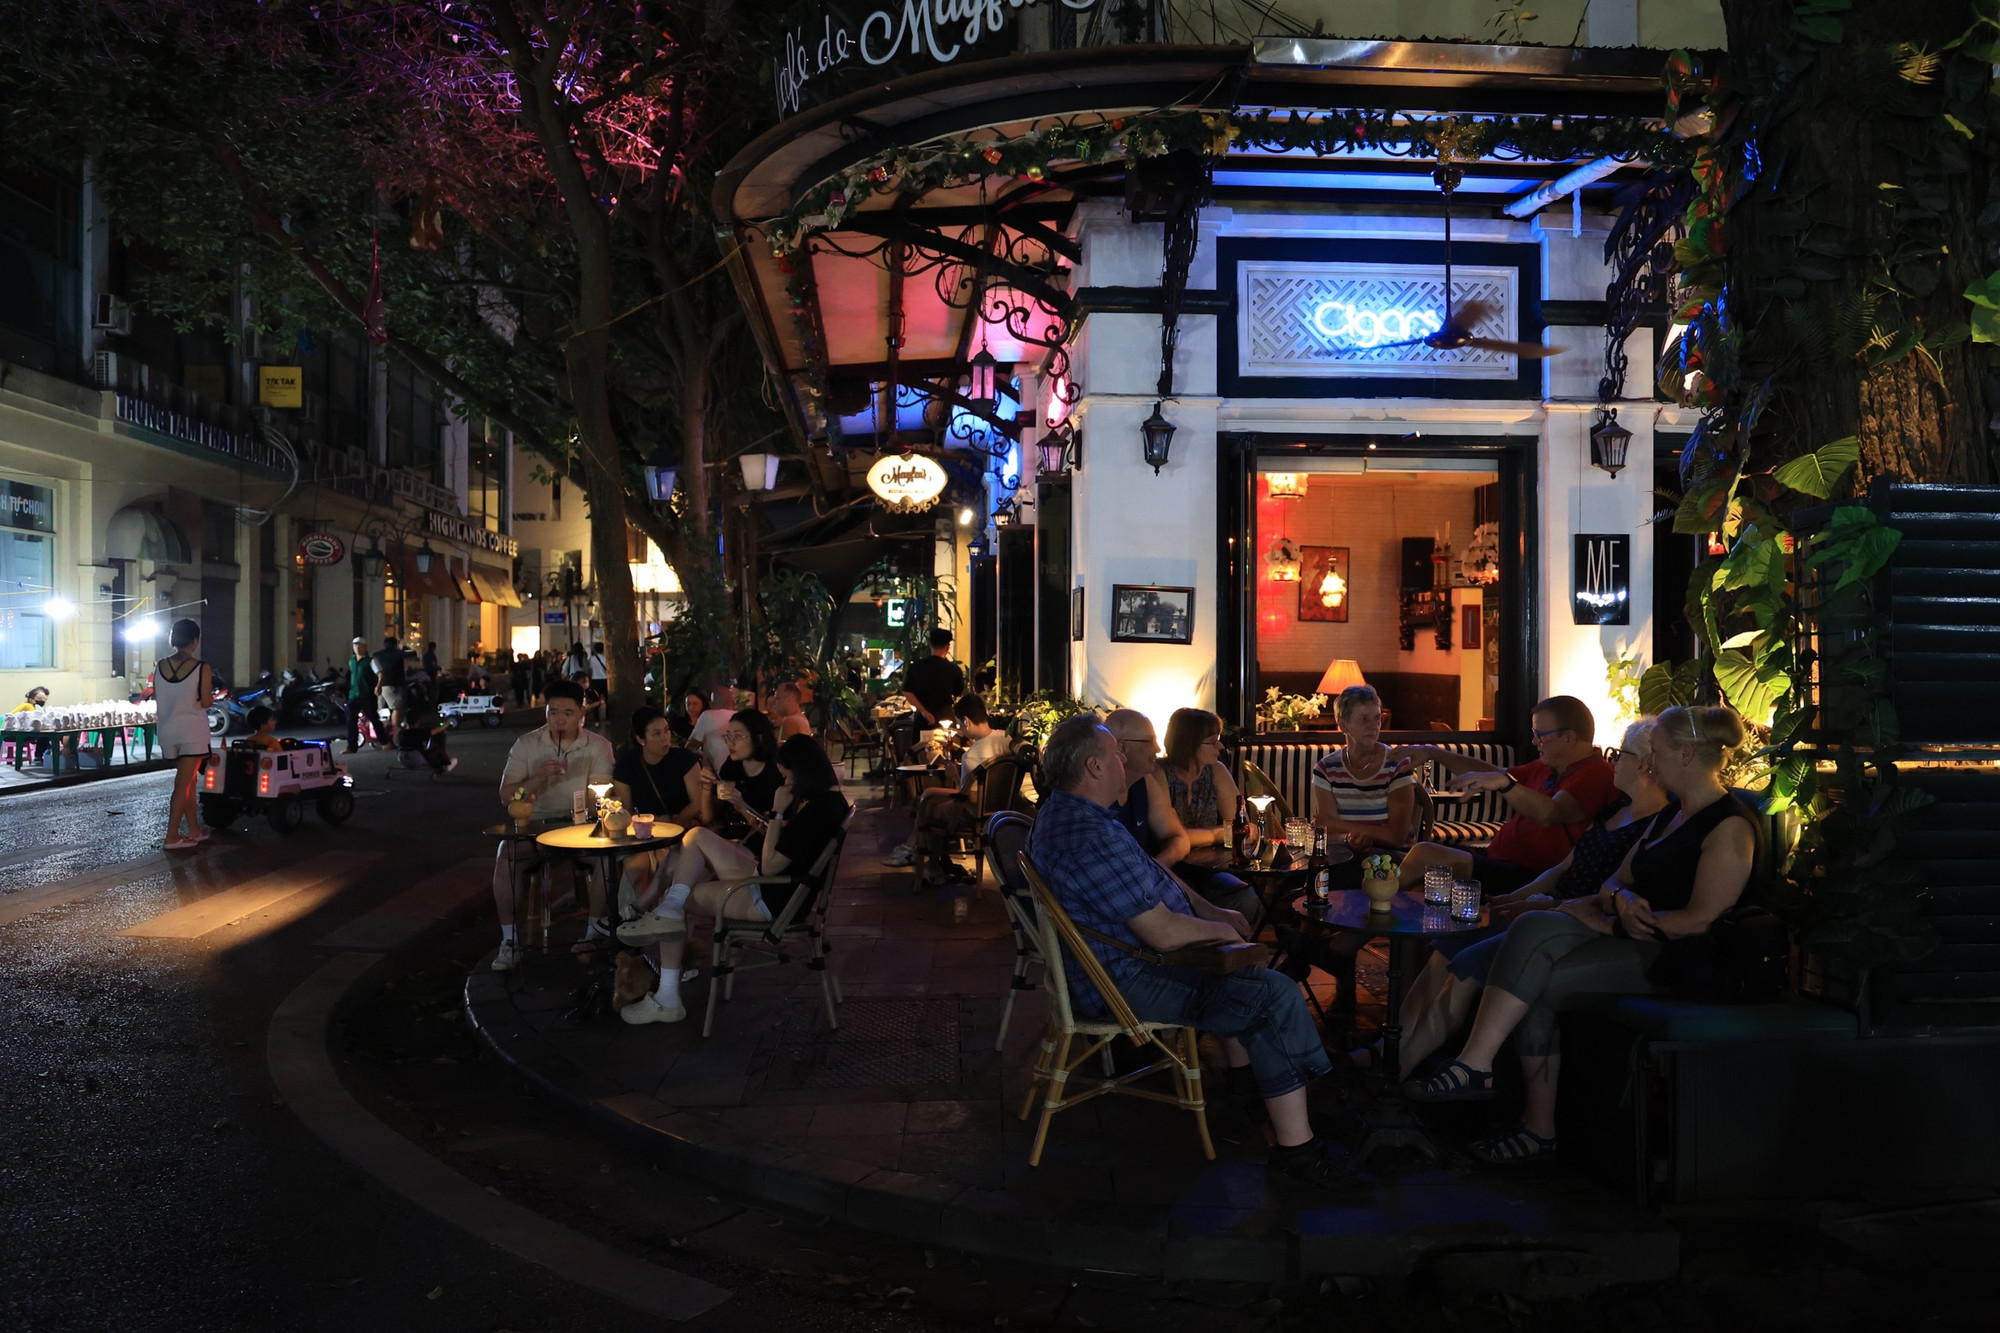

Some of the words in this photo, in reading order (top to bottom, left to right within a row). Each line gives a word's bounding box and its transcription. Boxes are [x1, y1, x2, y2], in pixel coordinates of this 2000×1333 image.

[817, 15, 851, 75] de
[1315, 301, 1441, 348] Cigars
[302, 534, 339, 549] HIGHLANDS
[429, 511, 487, 548] HIGHLANDS
[488, 532, 518, 558] COFFEE
[1586, 540, 1621, 596] MF
